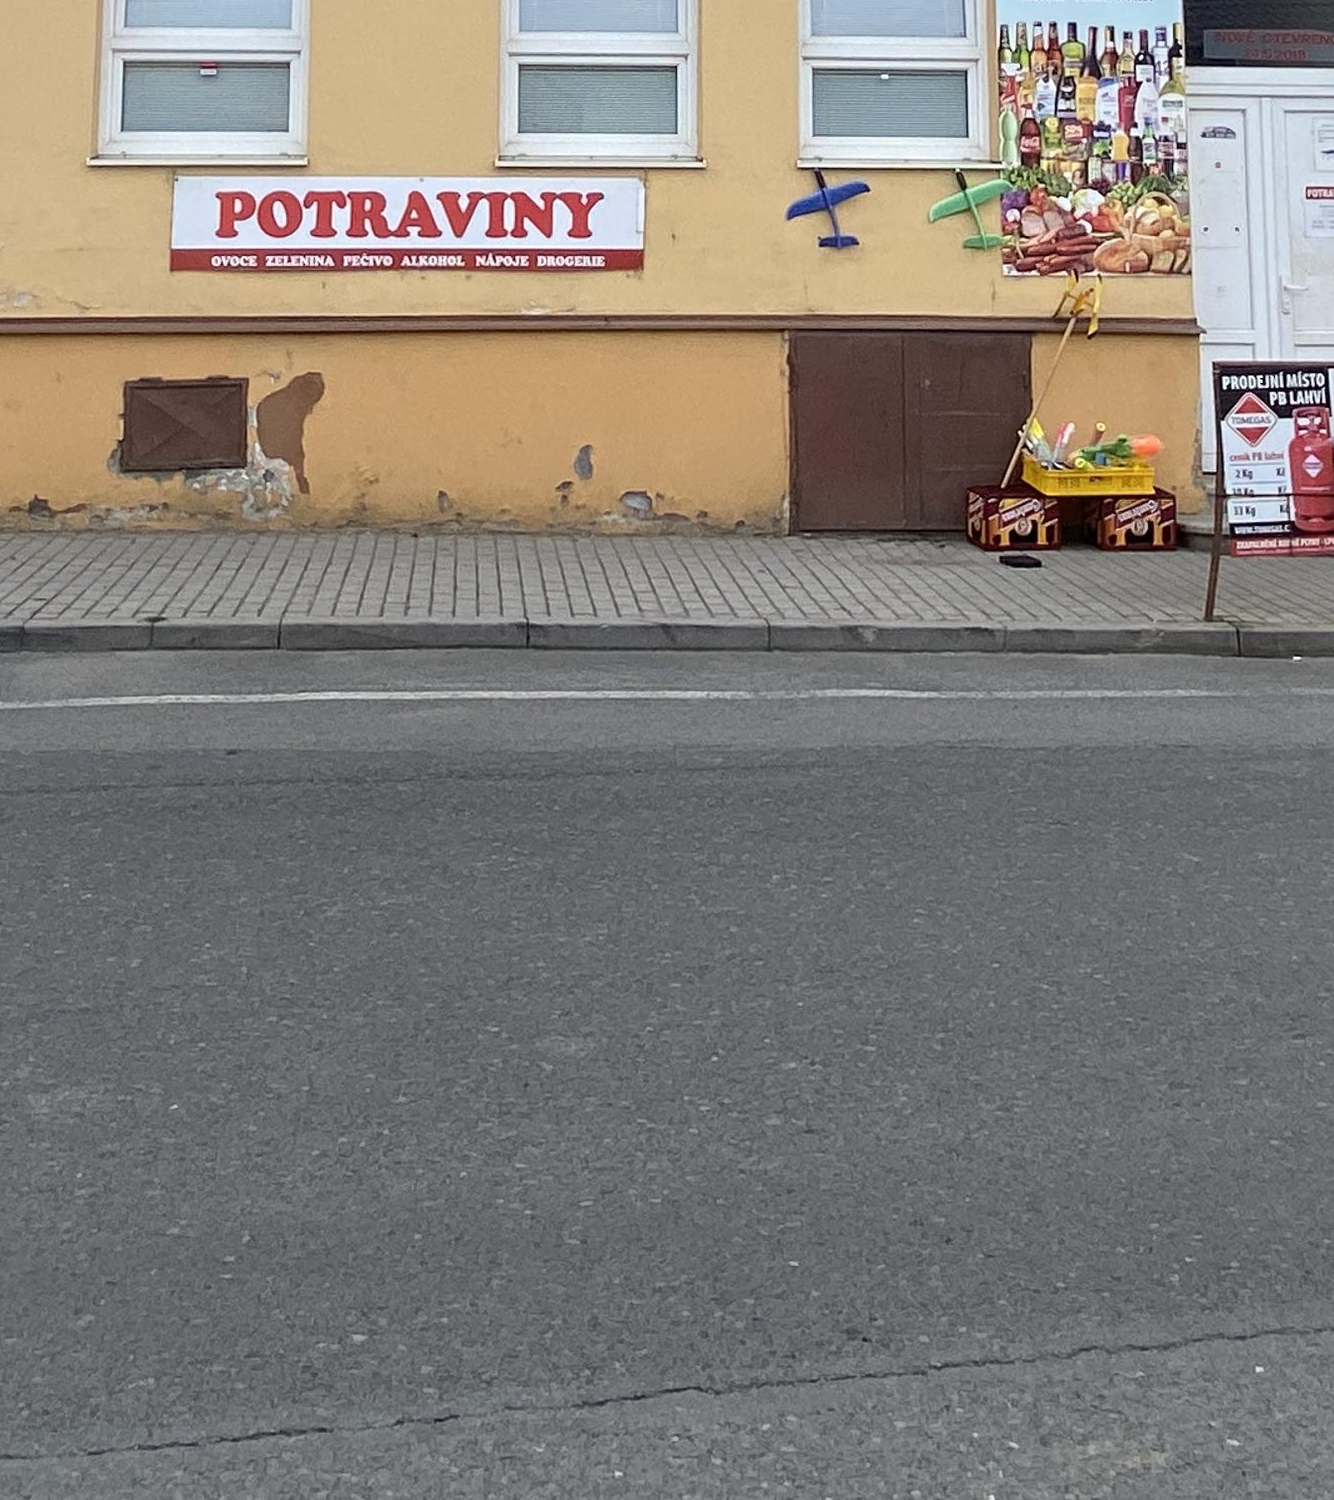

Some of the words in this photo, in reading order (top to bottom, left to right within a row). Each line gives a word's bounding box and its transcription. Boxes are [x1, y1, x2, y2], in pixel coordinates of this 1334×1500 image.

[215, 190, 605, 239] POTRAVINY
[211, 255, 258, 267] OVOCE
[265, 255, 335, 267] ZELENINA
[343, 252, 393, 267] PEČIVO
[401, 255, 466, 267] ALKOHOL
[475, 252, 530, 267] NÁPOJE
[537, 255, 606, 267] DROGERIE
[1221, 372, 1283, 390] PRODEJNÍ
[1286, 370, 1326, 388] MÍSTO
[1269, 391, 1287, 406] PB
[1289, 387, 1327, 405] LAHVÍ
[1231, 415, 1272, 425] TOMEGAS
